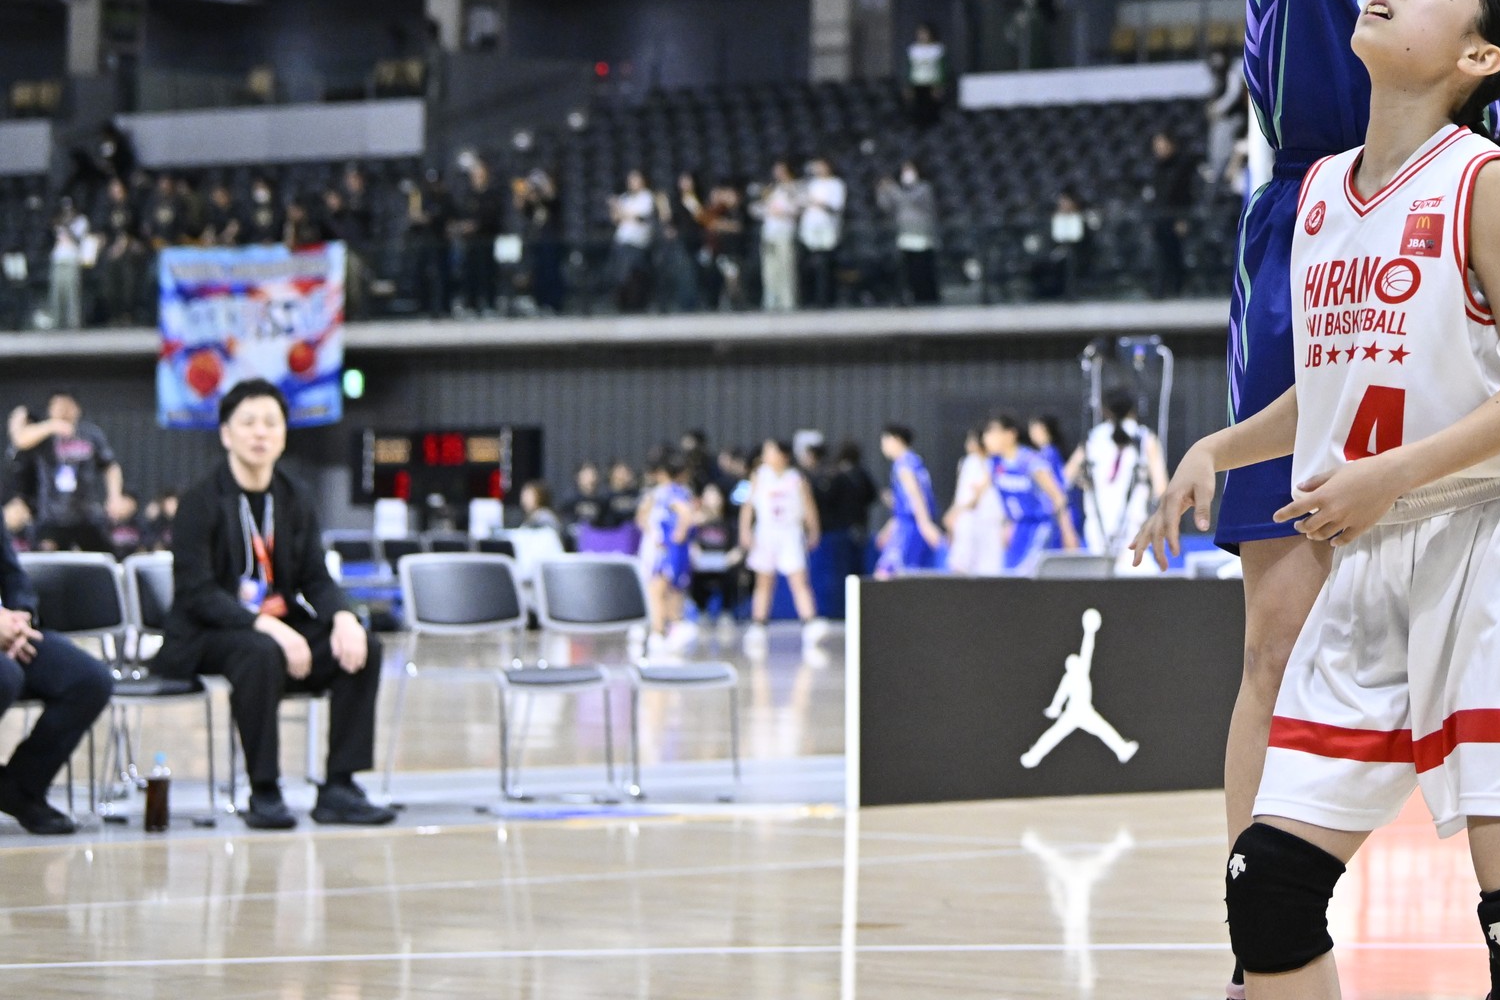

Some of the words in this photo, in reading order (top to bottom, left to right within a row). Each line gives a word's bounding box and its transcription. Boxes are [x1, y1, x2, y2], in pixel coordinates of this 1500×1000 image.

[1407, 238, 1426, 248] JBA
[1304, 256, 1421, 312] HIRANO
[1343, 384, 1406, 462] 4
